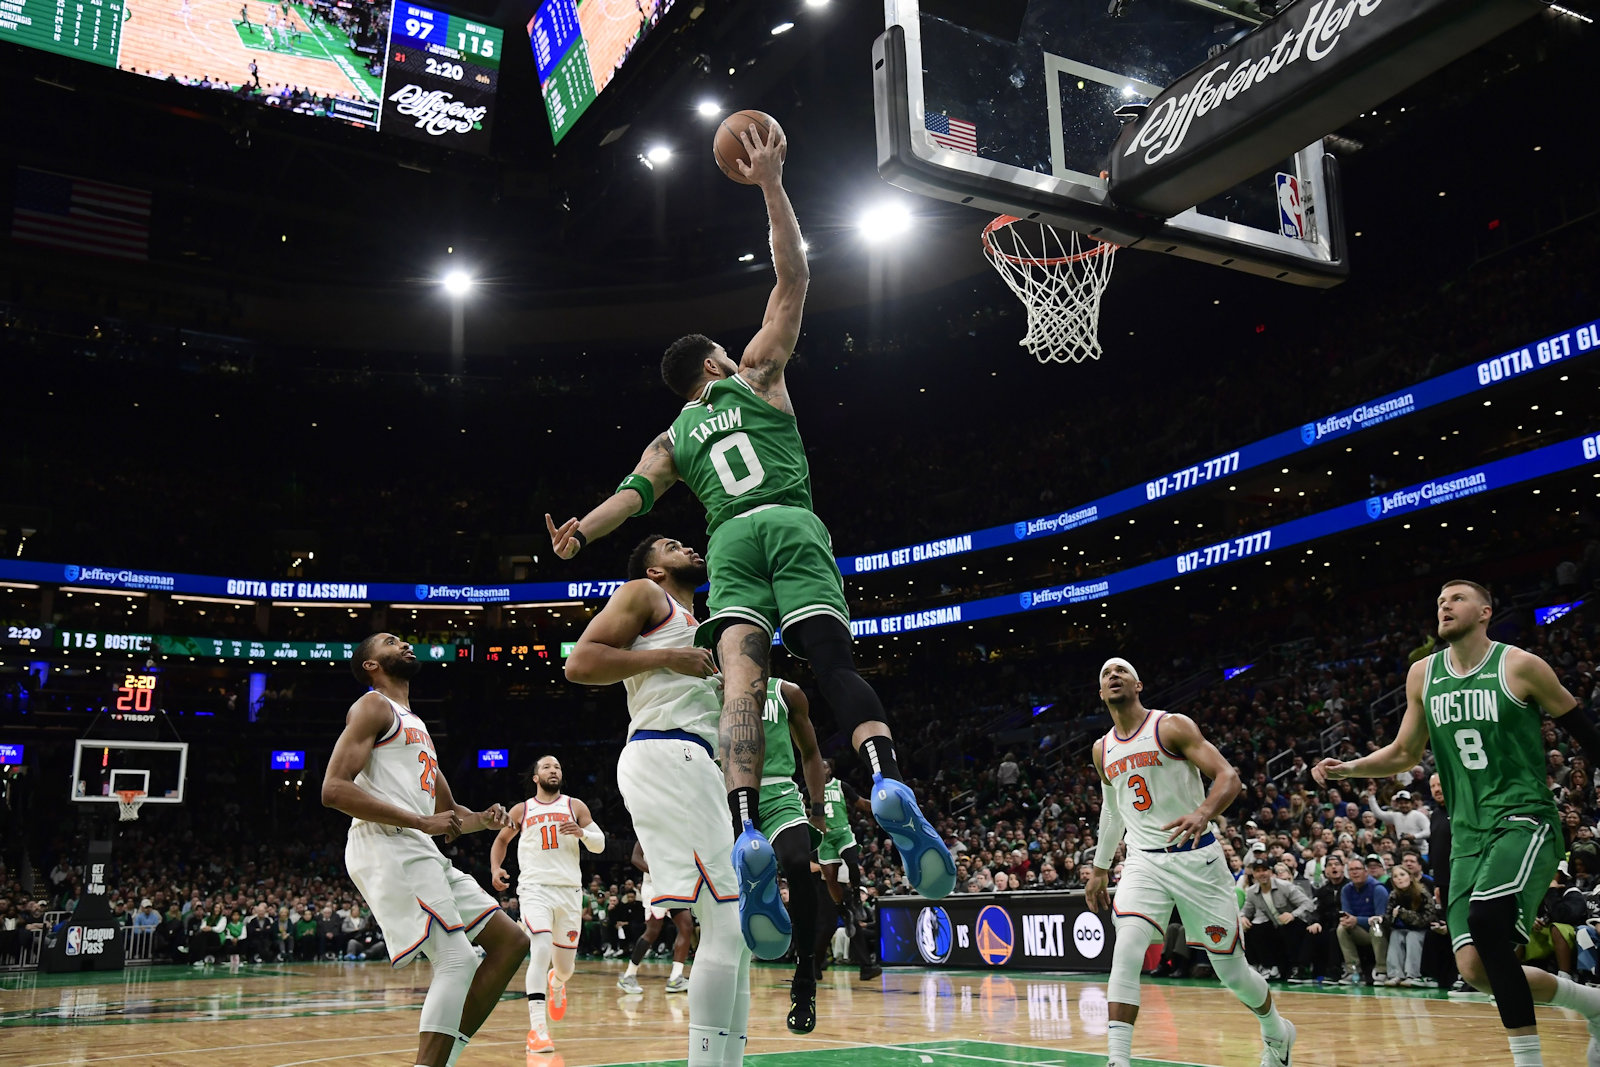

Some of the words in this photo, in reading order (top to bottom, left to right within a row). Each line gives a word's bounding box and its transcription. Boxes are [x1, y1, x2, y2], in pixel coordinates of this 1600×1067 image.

[405, 18, 434, 39] 97
[457, 32, 494, 58] 115
[394, 52, 406, 62] 21
[425, 57, 464, 80] 2:20
[475, 74, 490, 84] 4th
[388, 84, 487, 121] Different
[1124, 28, 1294, 165] Different
[415, 112, 474, 136] Here
[1477, 347, 1534, 385] GOTTA
[1536, 332, 1571, 365] GET
[689, 406, 742, 444] TATUM
[1361, 416, 1384, 428] INJURY
[1384, 405, 1415, 420] LAWYERS
[709, 431, 766, 497] 0
[1145, 451, 1240, 501] 617-777-7777
[1429, 493, 1454, 505] INJURY
[1454, 483, 1487, 499] LAWYERS
[855, 553, 890, 573] GOTTA
[891, 548, 911, 567] GET
[912, 535, 972, 562] GLASSMAN
[1176, 530, 1272, 574] 617-777-7777
[227, 579, 267, 597] GOTTA
[270, 582, 295, 597] GET
[297, 583, 368, 599] GLASSMAN
[850, 618, 878, 636] OTTA
[881, 613, 903, 633] GET
[904, 606, 962, 630] GLASSMAN
[8, 626, 42, 640] 2:20
[62, 632, 97, 648] 115
[215, 646, 221, 655] 2
[234, 648, 240, 656] 2
[249, 649, 265, 657] 50.0
[310, 650, 331, 658] 16/41
[458, 648, 468, 657] 21
[486, 653, 499, 661] 115
[511, 645, 528, 654] 2:20
[538, 650, 548, 658] 97
[125, 674, 156, 689] 2:20
[117, 687, 152, 711] 20
[1430, 689, 1499, 728] BOSTON
[123, 714, 155, 722] TISSOT
[1454, 728, 1489, 770] 8
[1105, 757, 1128, 781] NEW
[1125, 750, 1163, 770] YORK
[1128, 774, 1152, 812] 3
[526, 815, 545, 828] NEW
[547, 812, 571, 823] YORK
[541, 825, 559, 850] 11
[751, 839, 760, 850] 0
[91, 873, 103, 883] THE
[92, 863, 105, 874] GET
[93, 883, 106, 895] App
[83, 926, 114, 942] League
[957, 924, 969, 948] VS
[1022, 914, 1065, 957] NEXT
[1076, 927, 1102, 941] abc
[81, 940, 104, 954] Pass
